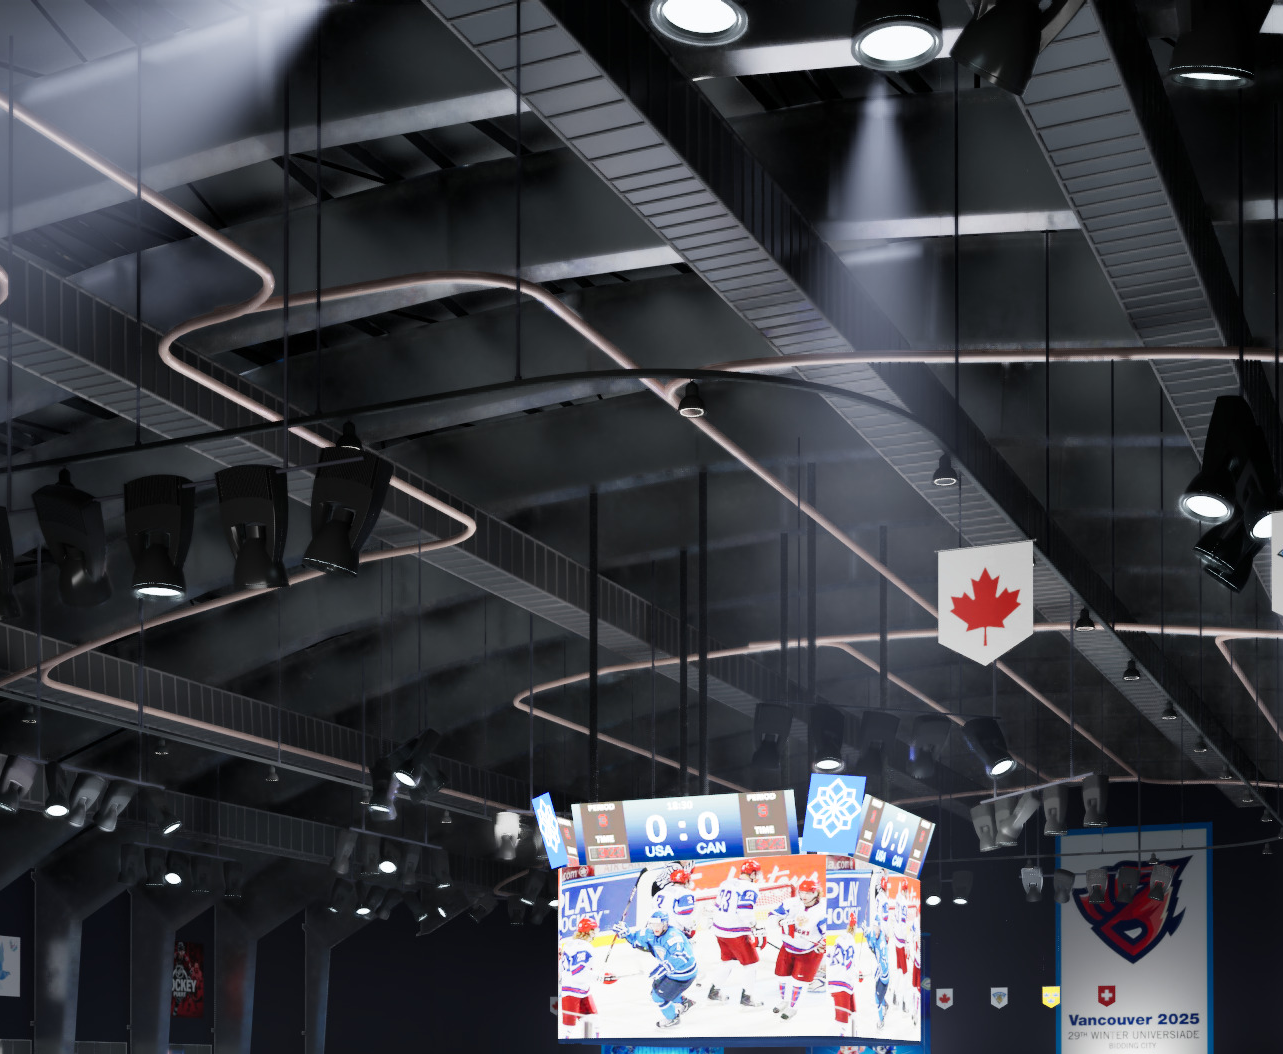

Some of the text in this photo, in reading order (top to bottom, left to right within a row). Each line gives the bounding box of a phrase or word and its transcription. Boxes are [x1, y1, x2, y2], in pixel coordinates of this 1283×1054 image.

[645, 841, 727, 858] USA CAN
[1068, 1012, 1200, 1026] Vancouver 2025
[1091, 1031, 1129, 1040] WINTER
[1132, 1029, 1200, 1039] UNIVERSIADE
[1108, 1042, 1139, 1050] BIDDING
